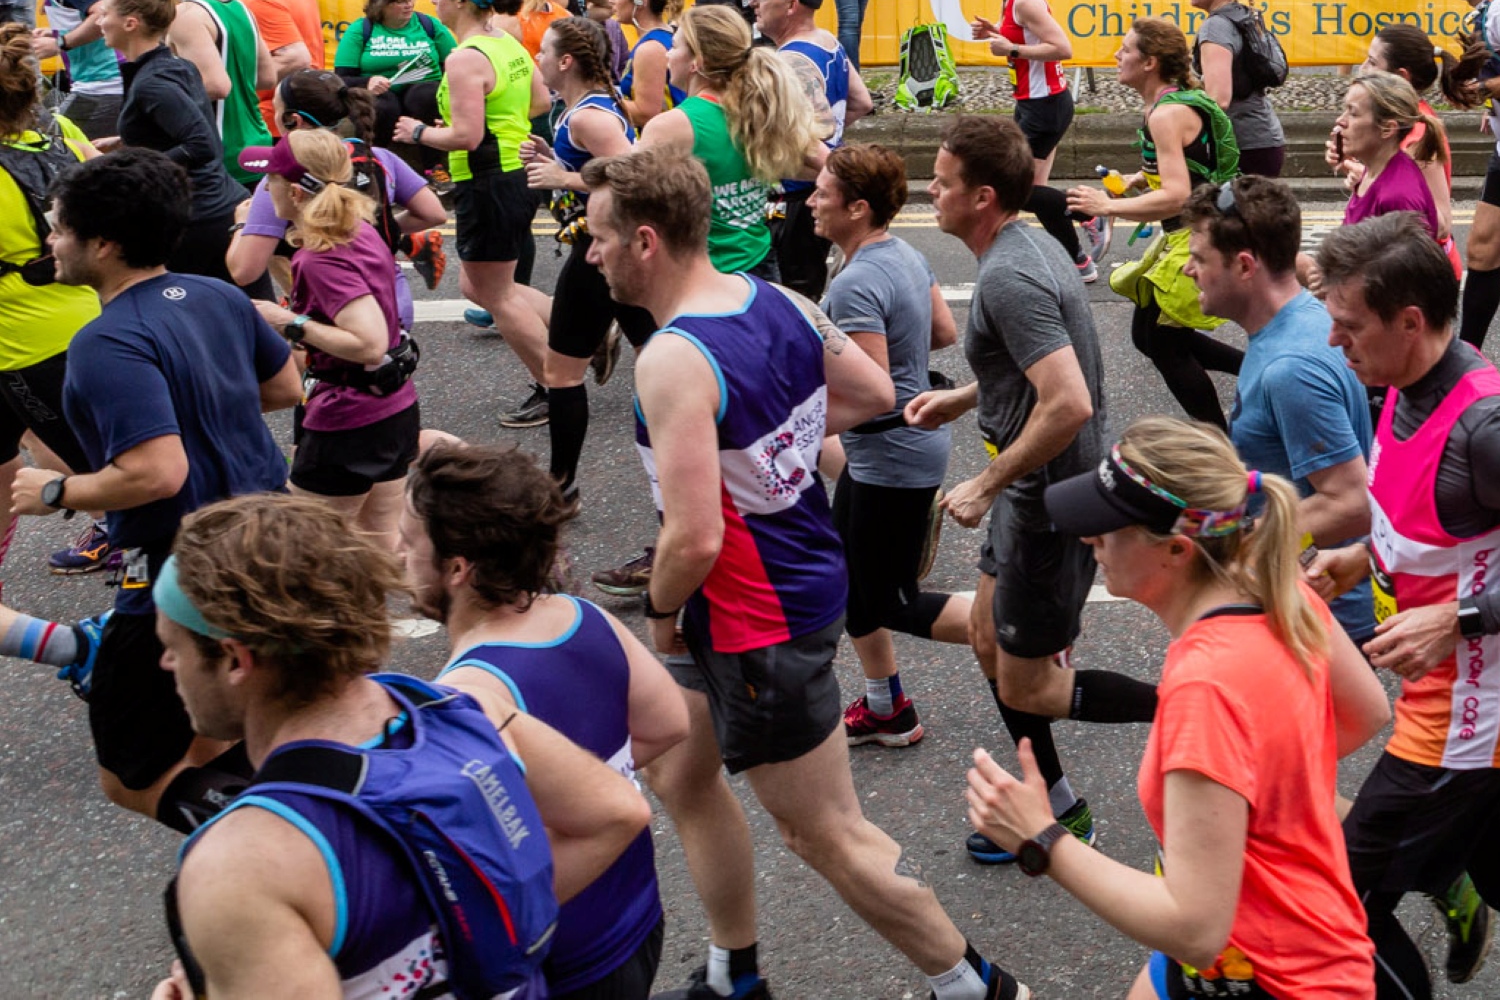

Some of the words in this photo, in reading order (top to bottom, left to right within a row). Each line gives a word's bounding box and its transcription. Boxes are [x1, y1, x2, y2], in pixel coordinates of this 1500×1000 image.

[1067, 2, 1292, 39] Chidr's
[714, 182, 739, 197] WE
[1473, 548, 1498, 597] brea
[1467, 636, 1484, 688] ncer
[1459, 696, 1480, 741] care
[461, 759, 531, 850] CAMELBAK
